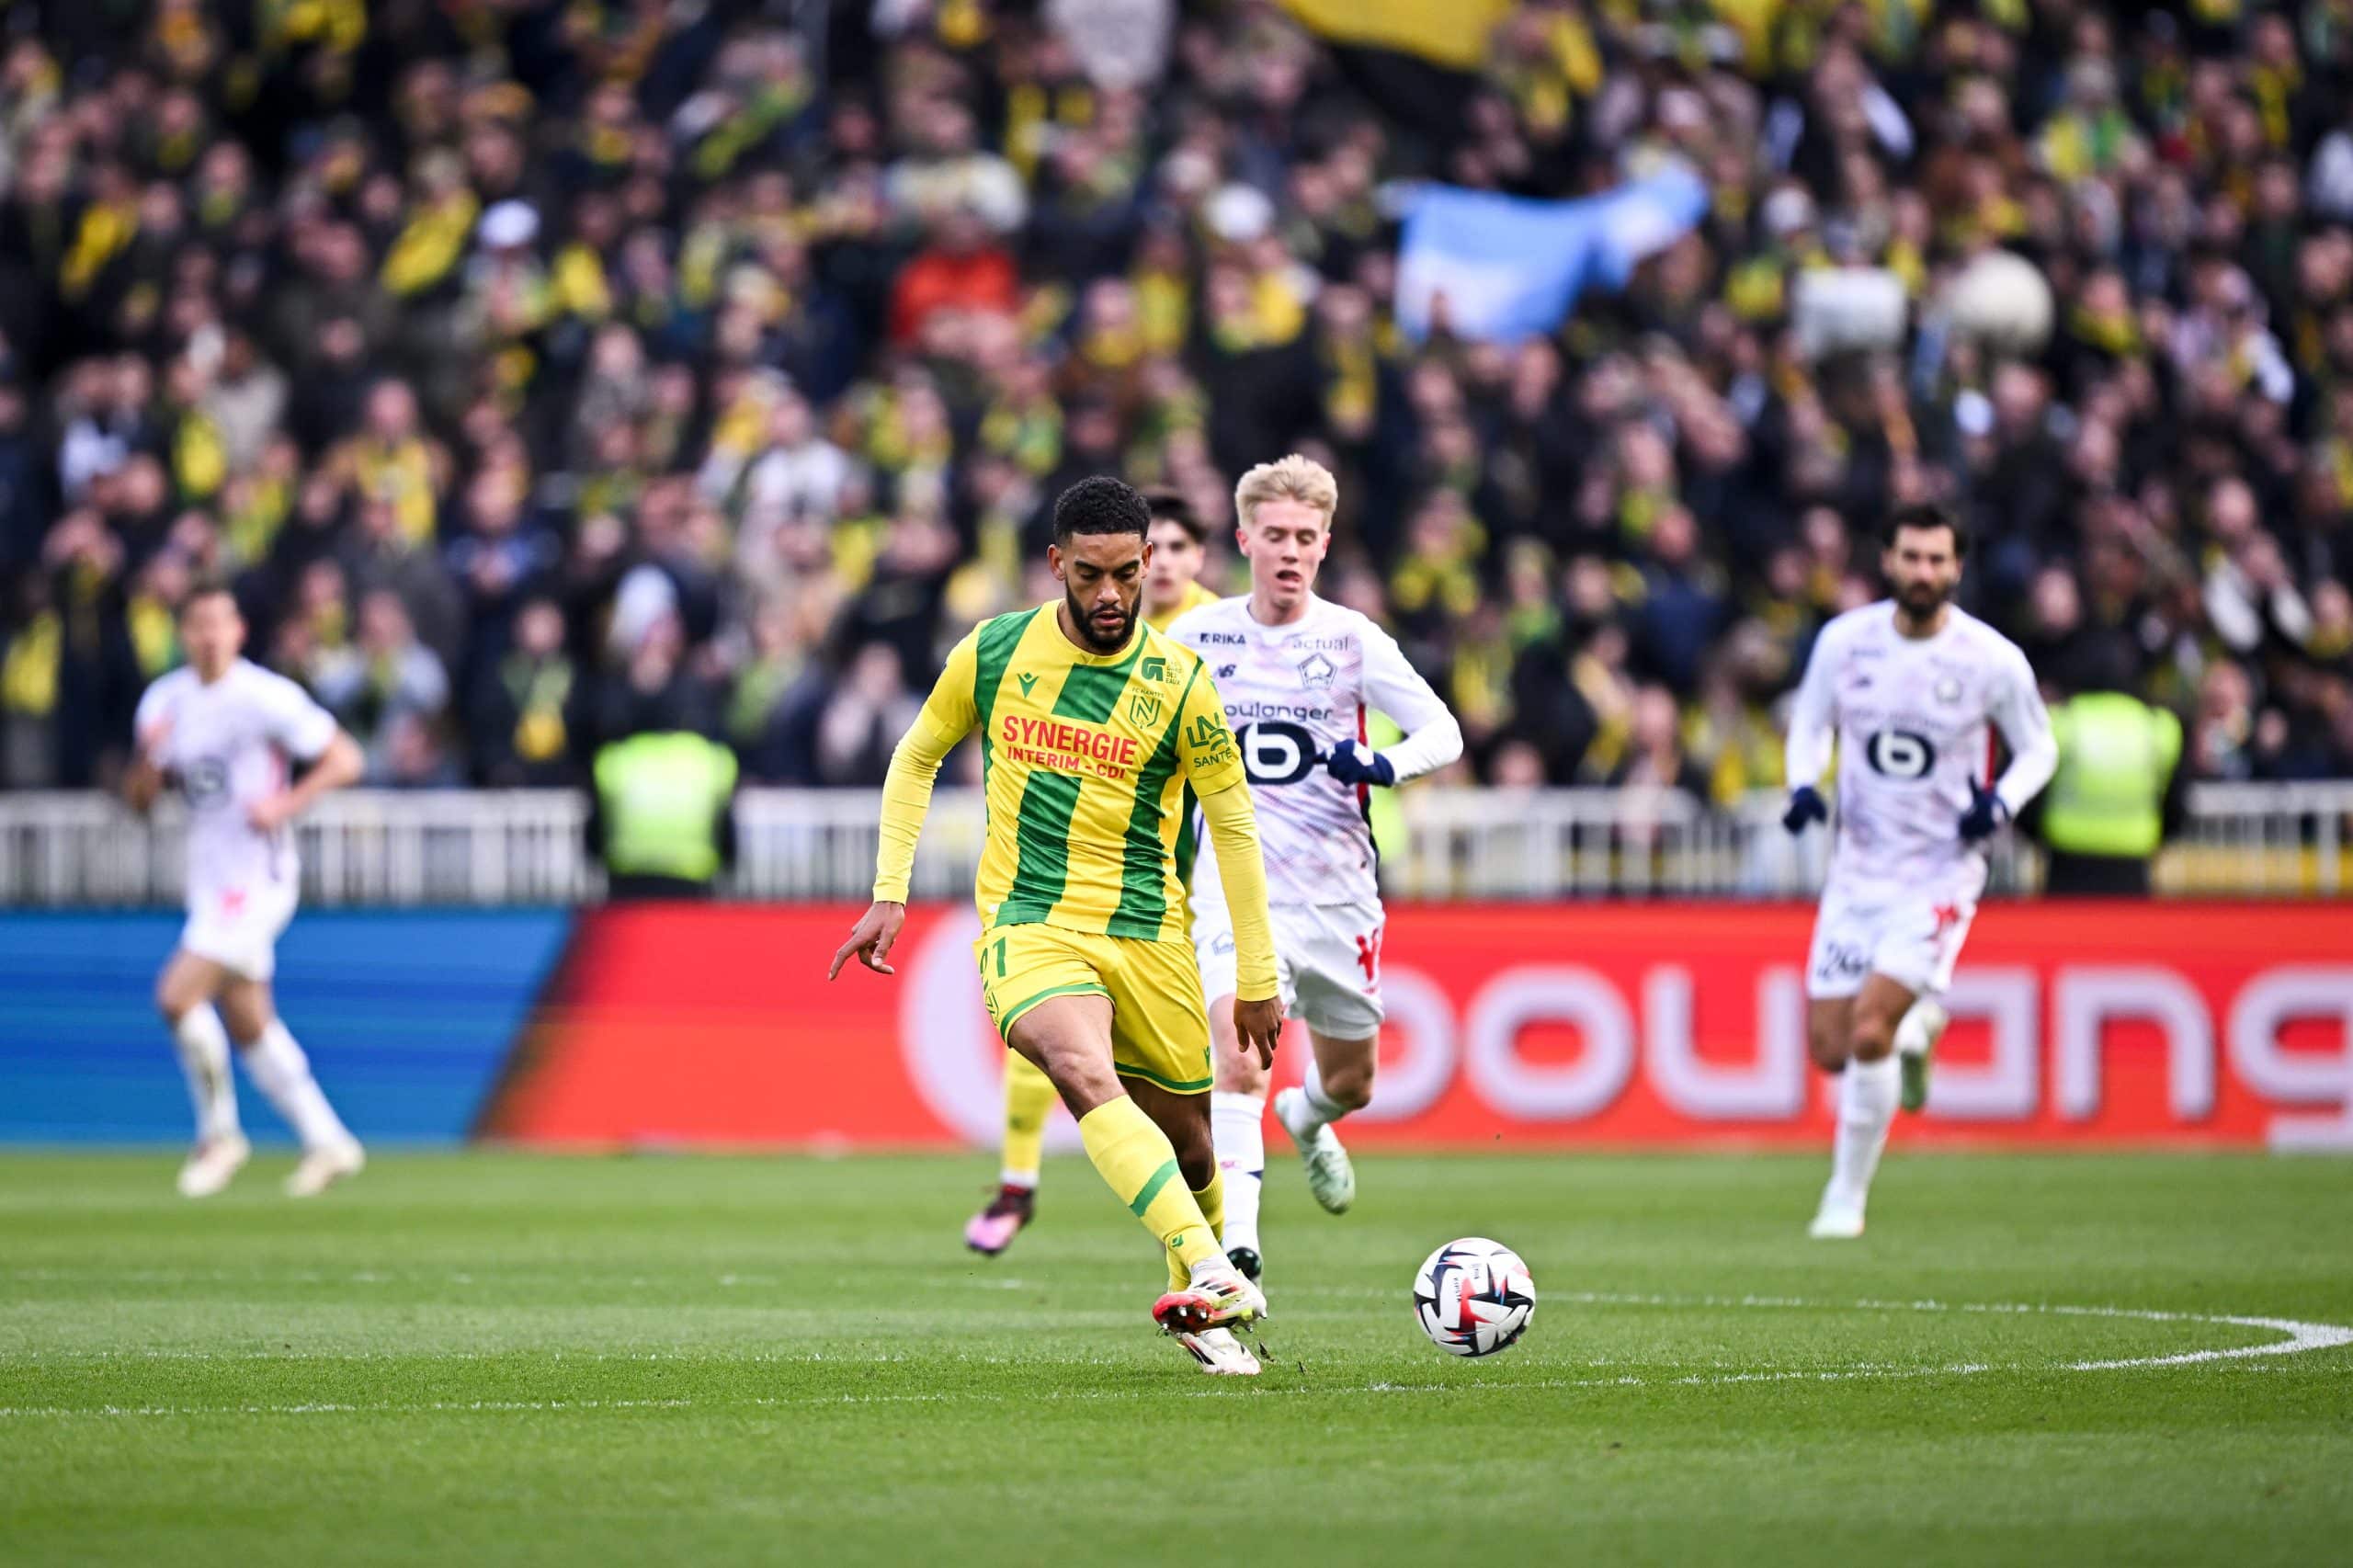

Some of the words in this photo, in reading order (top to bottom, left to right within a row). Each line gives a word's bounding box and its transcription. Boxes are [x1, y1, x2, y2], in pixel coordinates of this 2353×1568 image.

[1292, 635, 1349, 652] actual
[1223, 701, 1334, 722] oulanger
[1002, 715, 1139, 766] SYNERGIE
[1006, 745, 1080, 771] INTERIM
[1096, 763, 1126, 779] CDI
[1193, 745, 1233, 768] SANTÉ
[1290, 963, 2353, 1154] ouang
